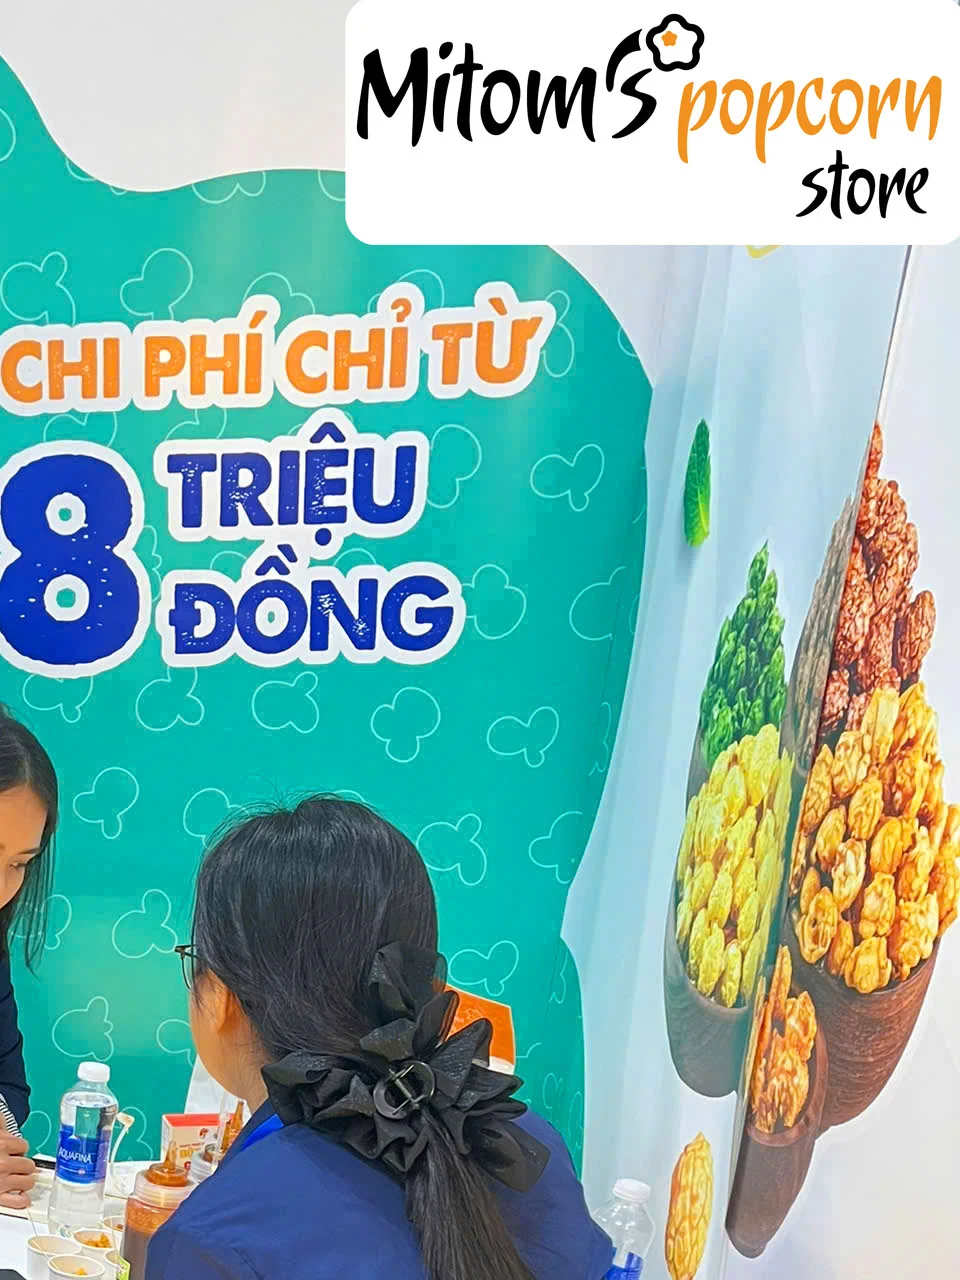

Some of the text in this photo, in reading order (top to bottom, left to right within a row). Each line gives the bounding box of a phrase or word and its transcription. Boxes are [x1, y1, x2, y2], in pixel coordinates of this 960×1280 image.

[0, 297, 543, 402] CHI PHÍ CHỈ TỪ
[167, 422, 417, 547] TRIỆU
[168, 544, 455, 655] ĐỒNG
[58, 1146, 94, 1165] AQUAFINA
